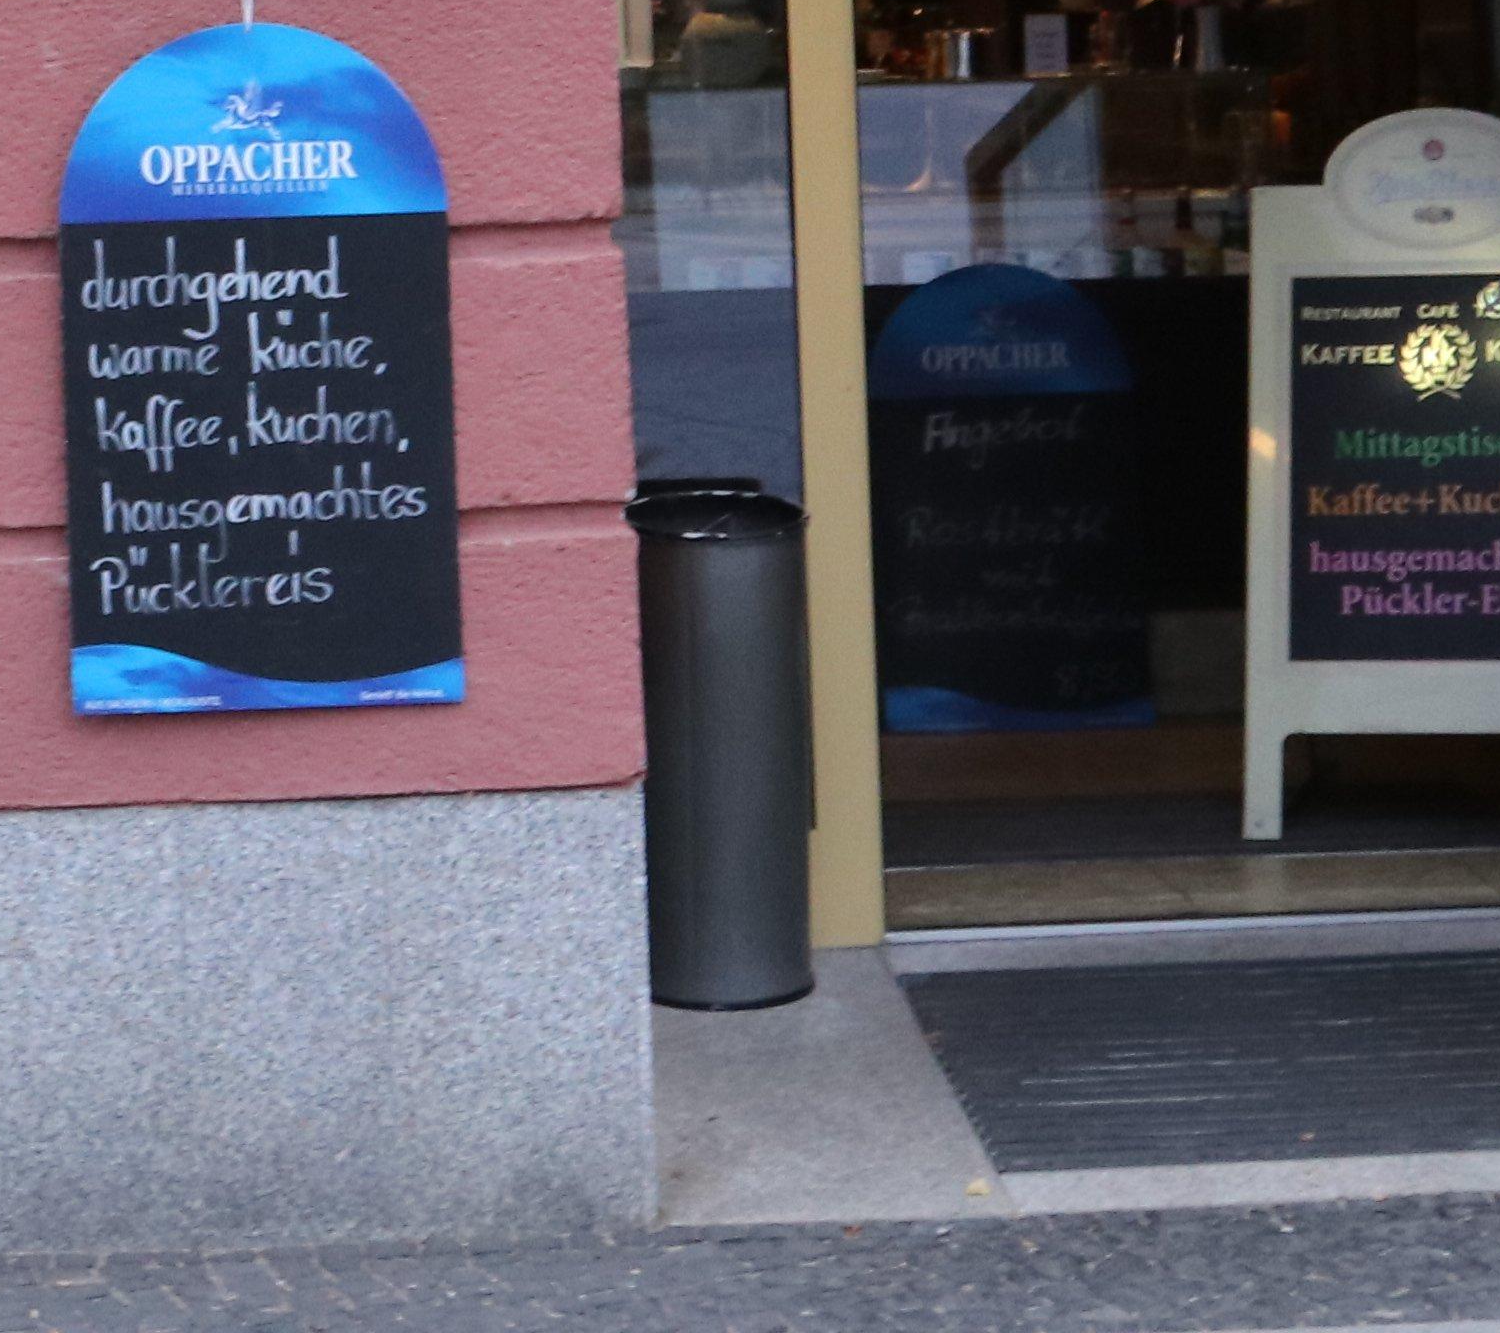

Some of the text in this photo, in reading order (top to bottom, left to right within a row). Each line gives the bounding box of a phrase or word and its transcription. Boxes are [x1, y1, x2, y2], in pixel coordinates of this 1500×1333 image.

[140, 139, 358, 186] OPPACHER
[81, 235, 349, 340] durchgehend
[88, 343, 220, 379] warme
[1300, 343, 1396, 366] KAFFEE
[101, 461, 428, 563] hausgemachtes
